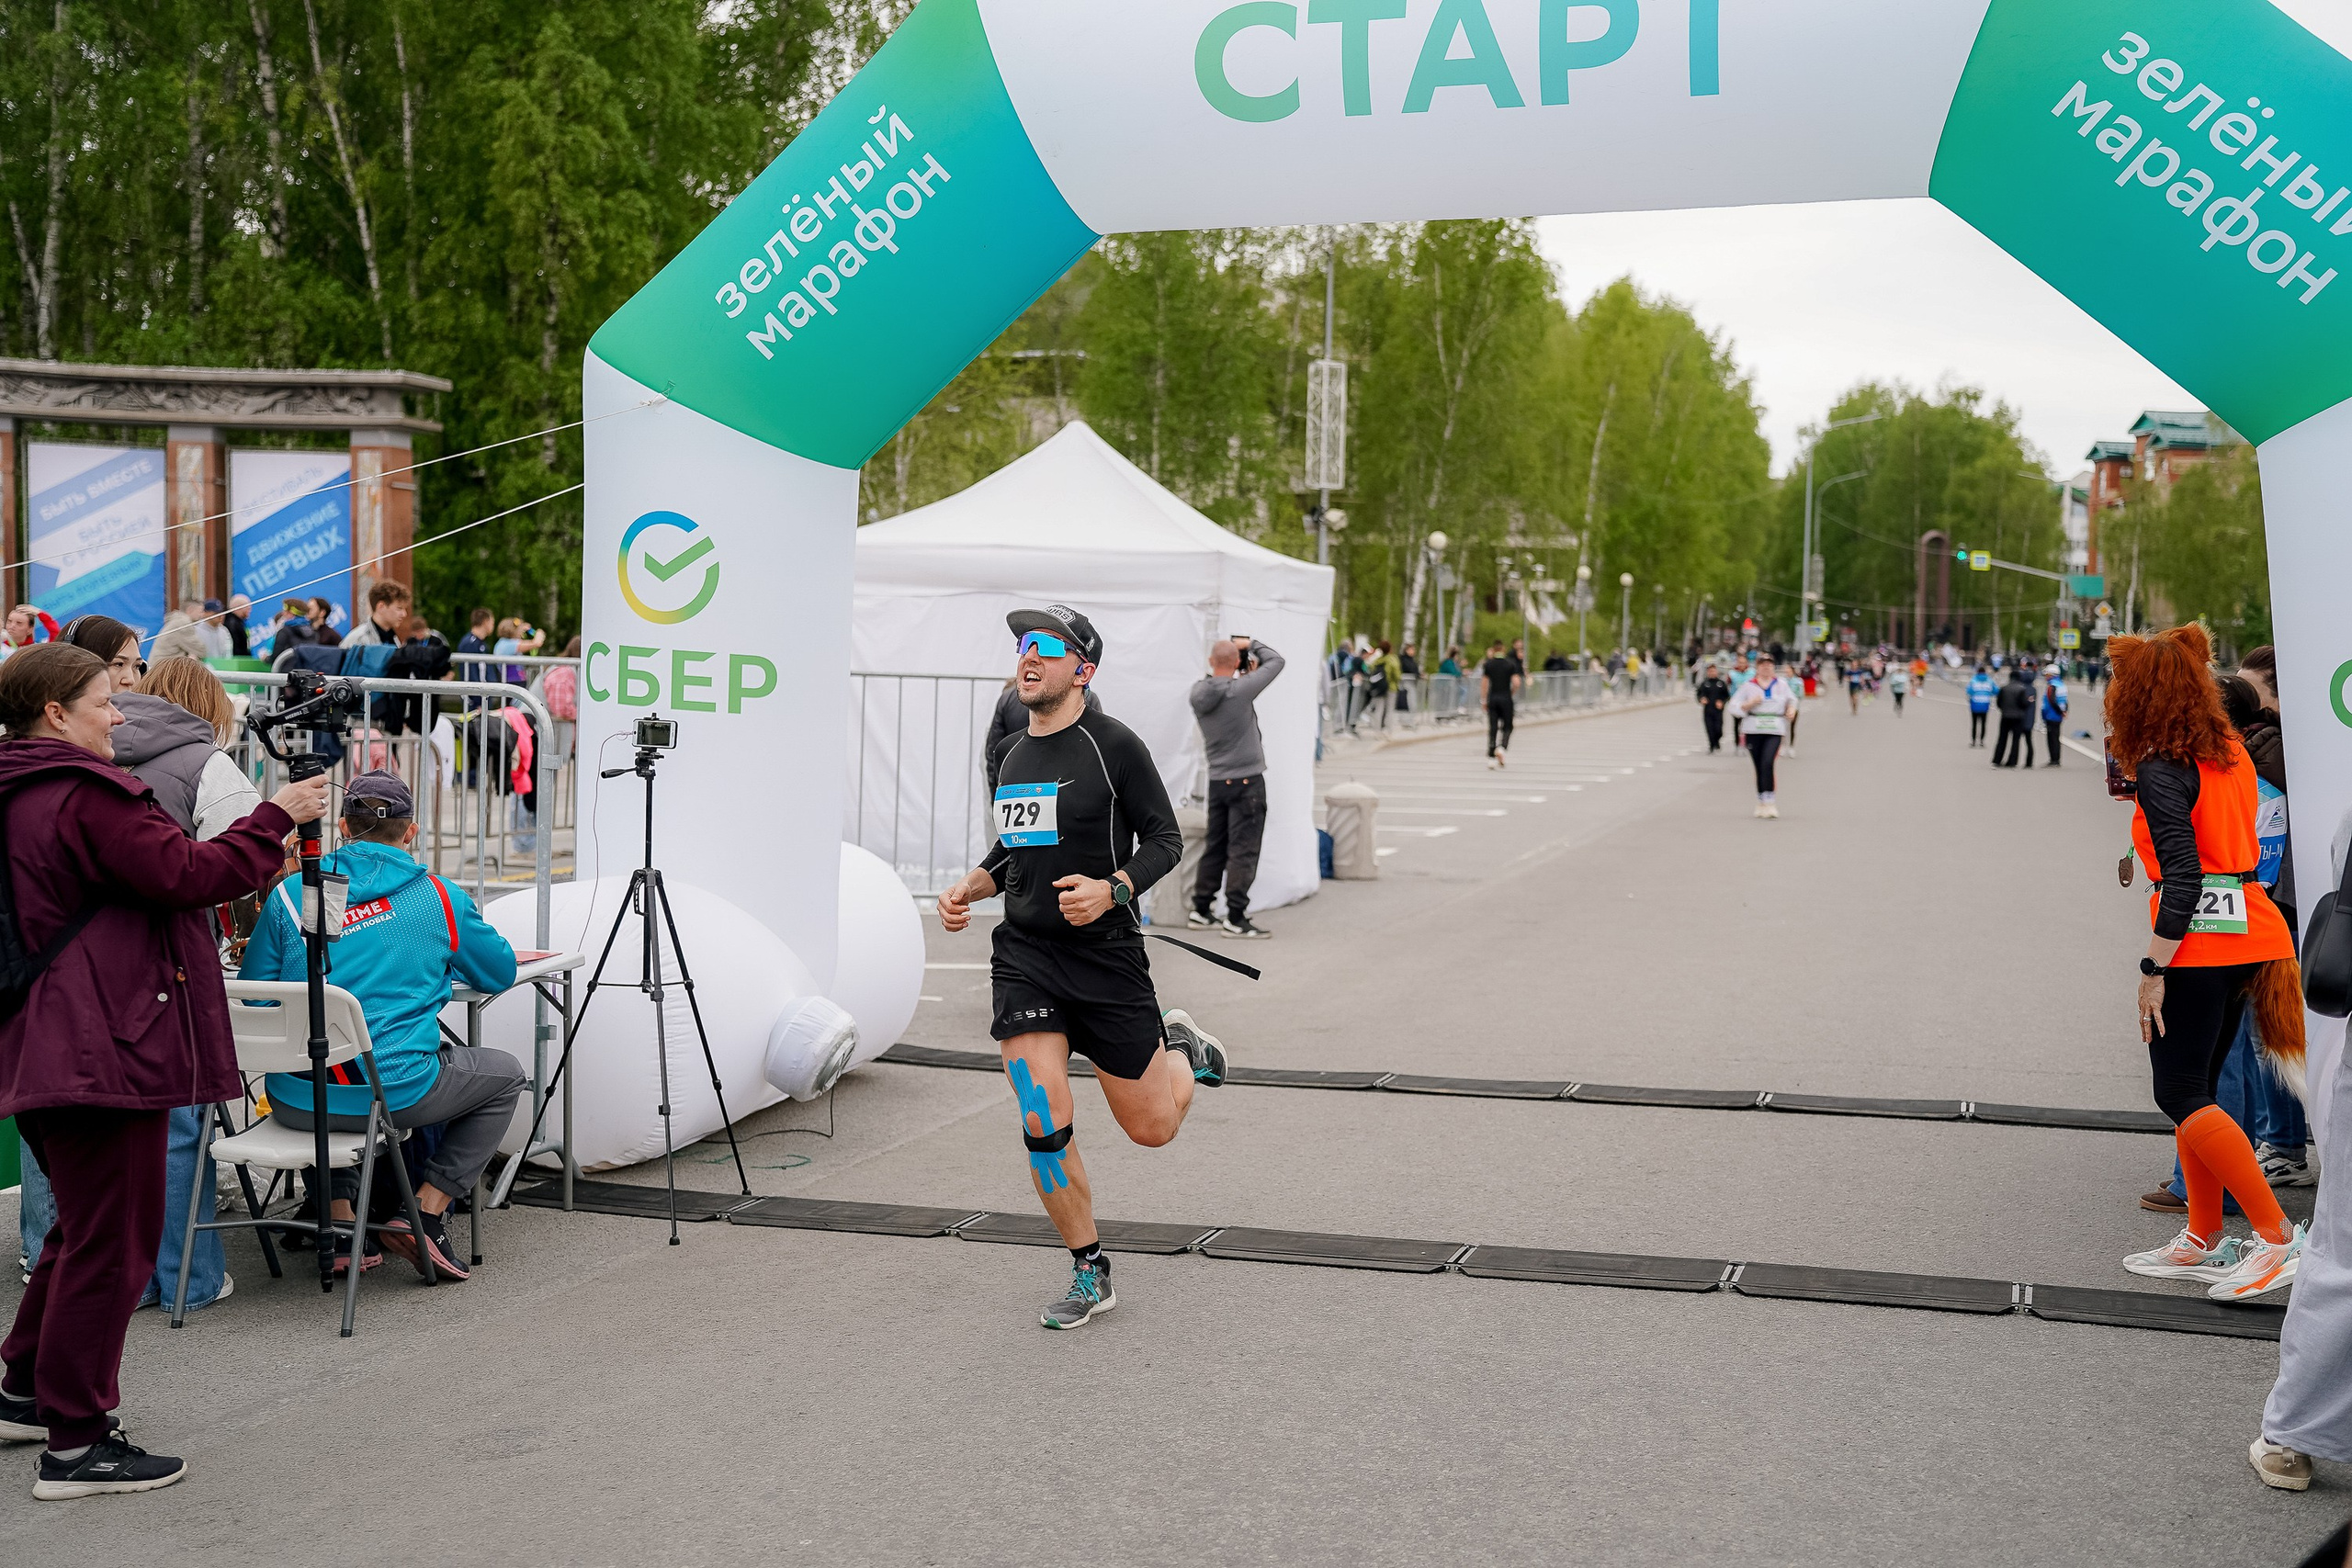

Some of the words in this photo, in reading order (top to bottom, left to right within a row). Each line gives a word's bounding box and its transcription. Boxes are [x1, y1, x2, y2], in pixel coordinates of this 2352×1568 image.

[714, 104, 915, 319] зелёный
[2050, 79, 2339, 306] марафон
[745, 152, 952, 361] марафон
[40, 491, 87, 522] БЫТЬ
[86, 458, 153, 500] ВМЕСТЕ
[241, 524, 346, 597] ПЕРВЫХ
[246, 500, 342, 568] ДВИЖЕНИЕ
[585, 641, 778, 715] СБЕР
[1001, 801, 1041, 829] 729
[340, 924, 362, 938] РЕМЯ
[344, 901, 383, 925] TIME
[2194, 891, 2234, 915] 21
